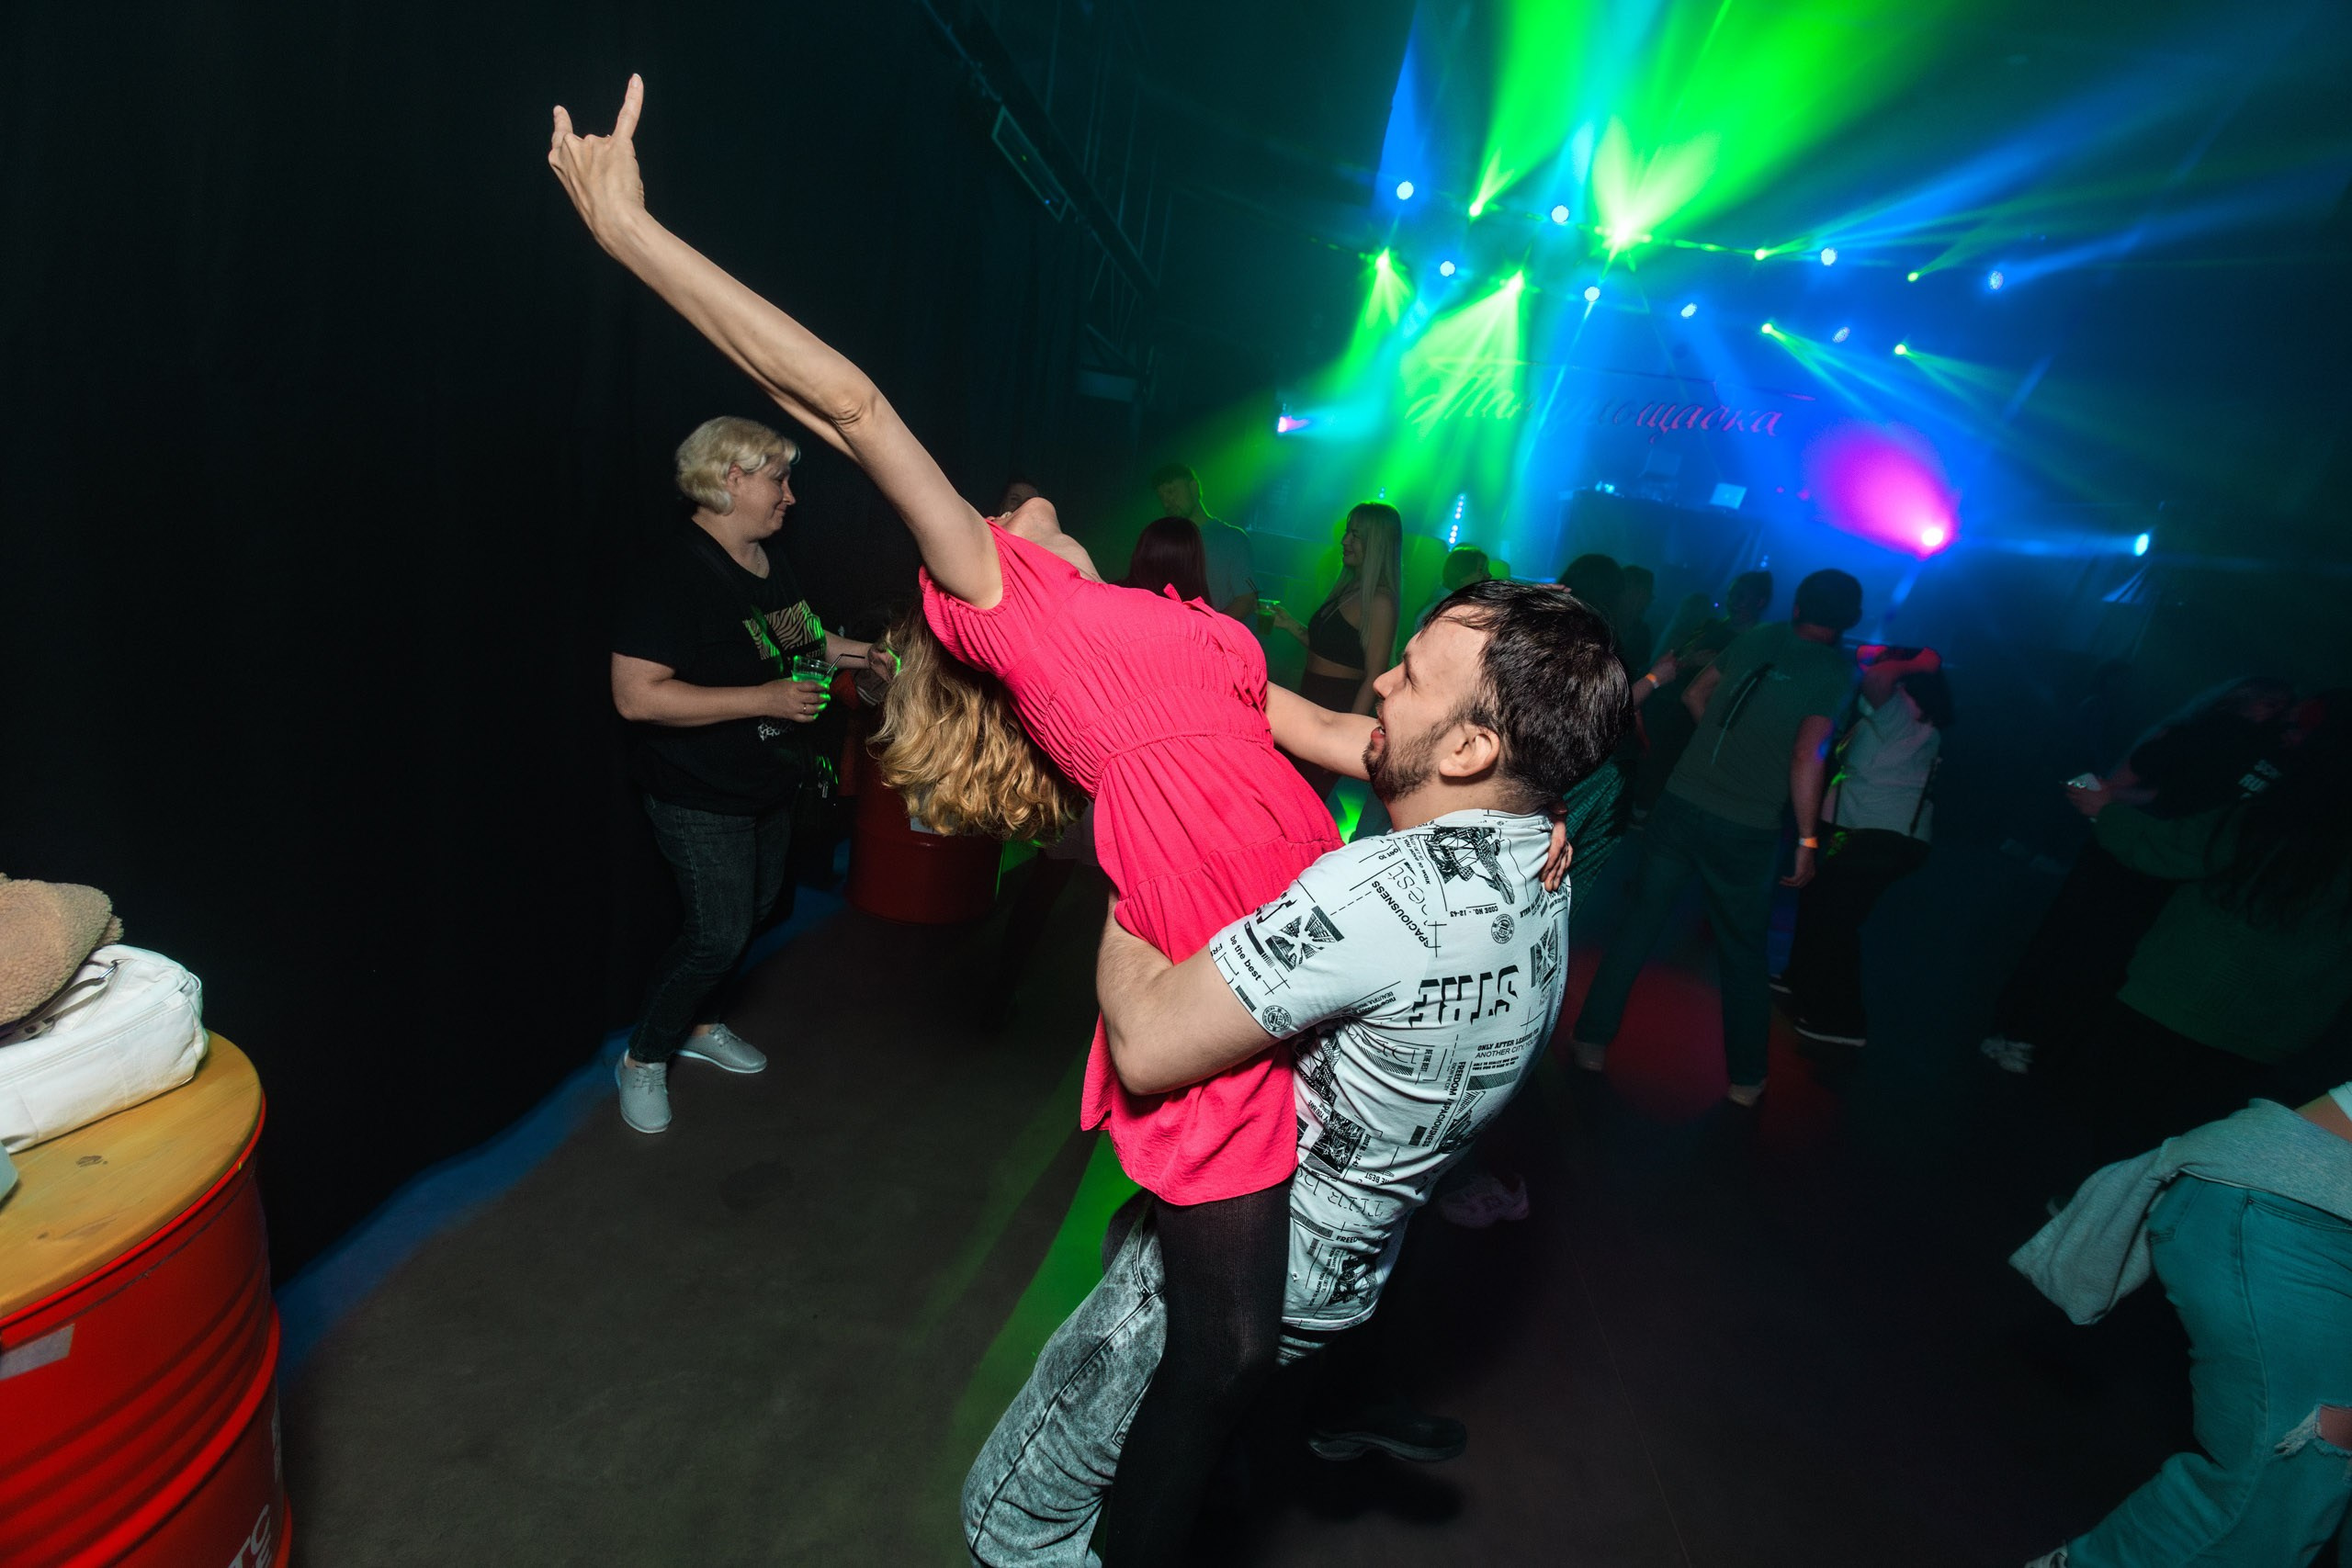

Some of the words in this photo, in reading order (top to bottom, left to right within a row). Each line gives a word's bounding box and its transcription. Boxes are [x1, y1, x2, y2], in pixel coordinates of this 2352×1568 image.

[1372, 880, 1429, 948] SPACIOUSNESS
[1230, 934, 1238, 945] be
[1234, 944, 1246, 960] the
[1244, 959, 1261, 981] best
[1475, 1047, 1510, 1058] ANOTHER
[1477, 1043, 1494, 1051] ONLY
[1495, 1039, 1514, 1048] AFTER
[1449, 1061, 1466, 1096] FREEDOM
[1422, 1102, 1453, 1147] SPACIOUSNESS
[1364, 1172, 1381, 1183] BEST
